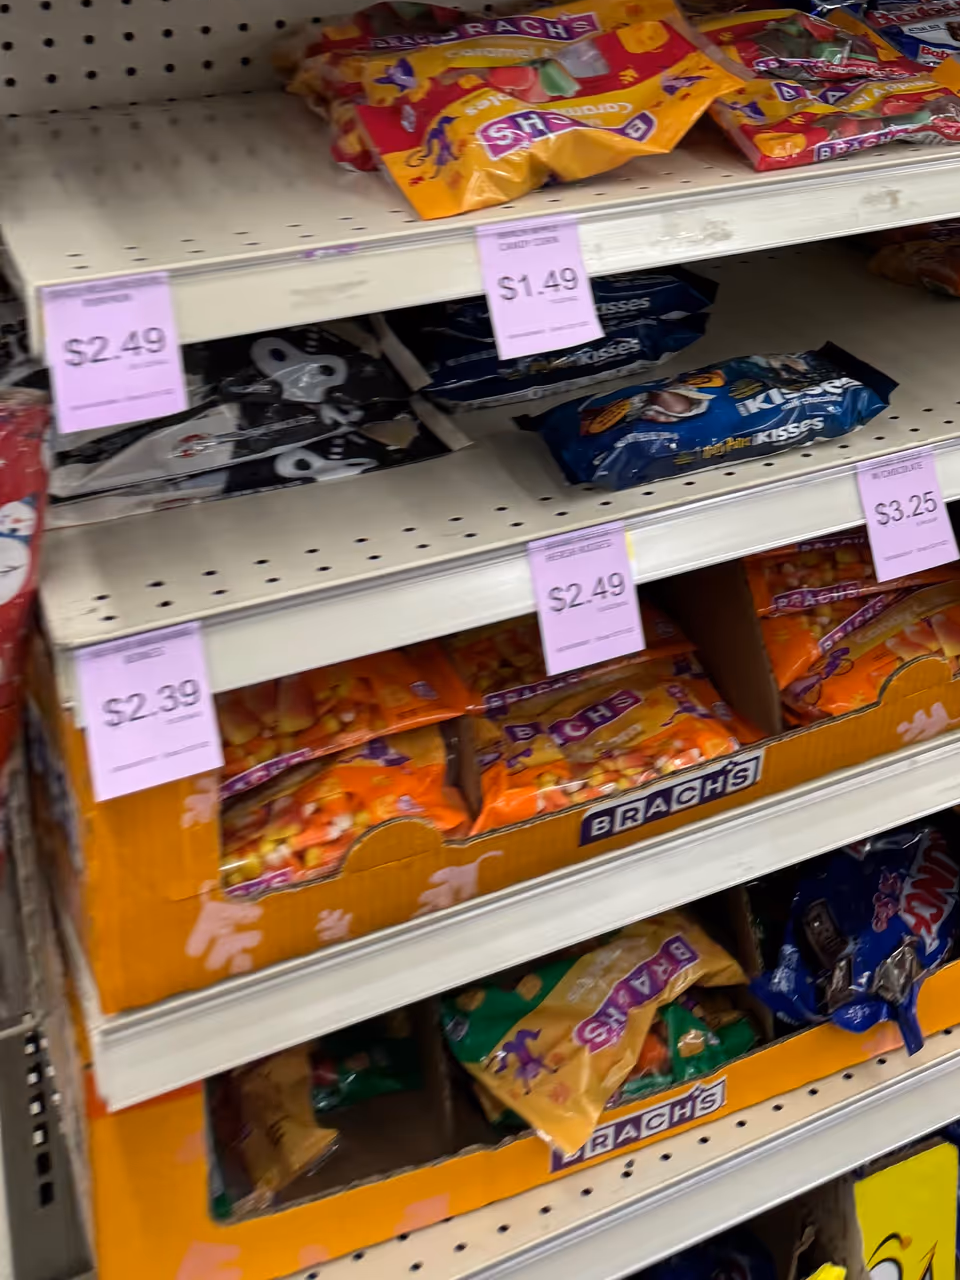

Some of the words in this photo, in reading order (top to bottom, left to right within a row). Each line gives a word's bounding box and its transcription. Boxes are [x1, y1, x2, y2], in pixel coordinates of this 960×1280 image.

[497, 267, 579, 303] $1.49
[65, 327, 166, 368] $2.49
[875, 491, 938, 526] $3.25
[549, 572, 626, 613] $2.49
[102, 678, 200, 729] $2.39
